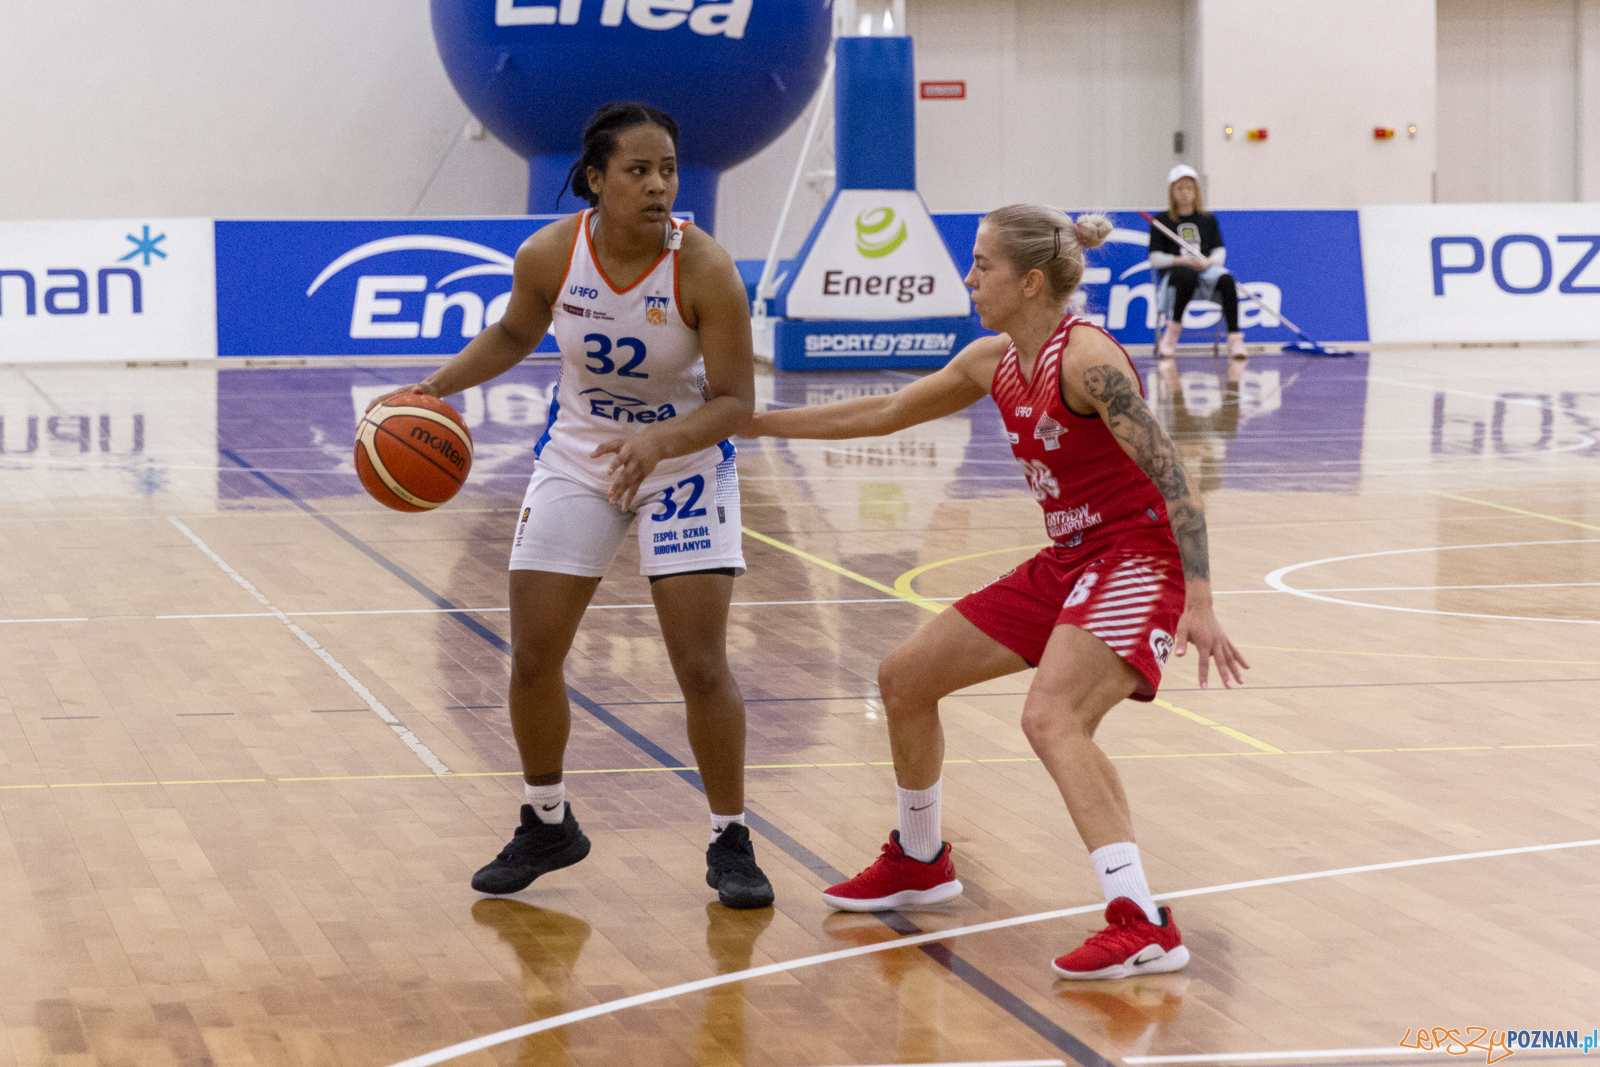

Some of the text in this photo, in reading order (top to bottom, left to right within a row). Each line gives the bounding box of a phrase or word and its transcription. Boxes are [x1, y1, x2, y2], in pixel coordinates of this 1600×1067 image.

[823, 270, 935, 303] Energa
[1431, 234, 1600, 296] POZ
[350, 275, 512, 339] En
[584, 333, 648, 379] 32
[590, 399, 676, 424] Enea
[410, 426, 465, 471] molten
[651, 474, 707, 522] 32
[653, 525, 710, 543] ZESPÓŁ SZKÓŁ
[654, 539, 711, 555] BUDOWLANYCH
